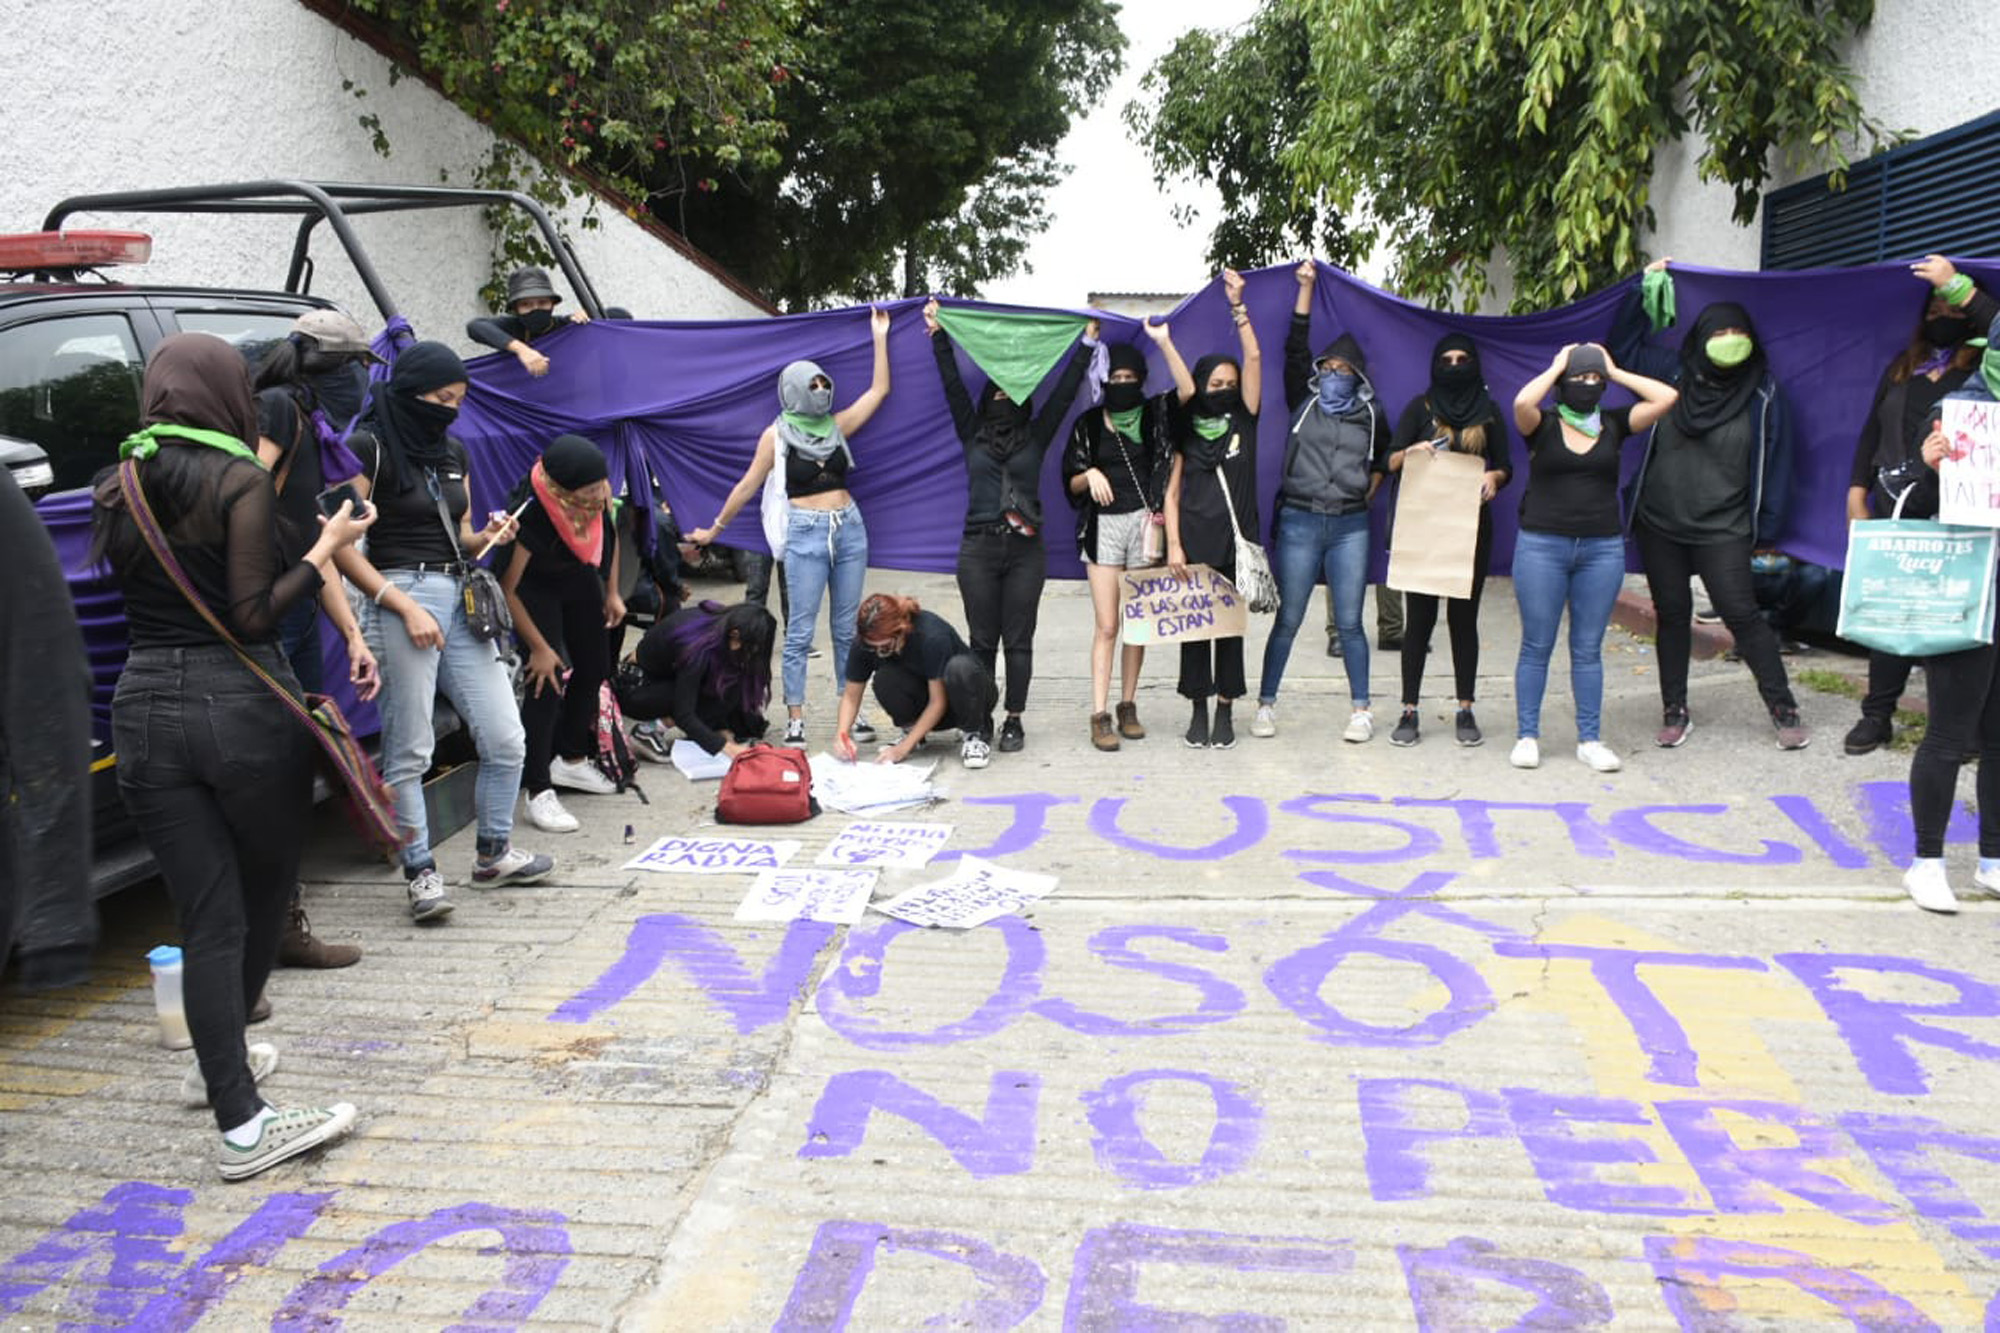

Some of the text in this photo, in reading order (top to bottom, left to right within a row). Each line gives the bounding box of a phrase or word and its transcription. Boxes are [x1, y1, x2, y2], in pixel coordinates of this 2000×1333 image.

[1867, 537, 1974, 554] ABARROTES
[1125, 573, 1181, 599] SOMOS
[1125, 602, 1144, 619] DE
[1150, 595, 1178, 614] LAS
[1181, 593, 1214, 611] QUE
[1157, 610, 1214, 637] ESTAN
[637, 852, 779, 868] RABIA
[659, 839, 776, 855] DIGNA
[797, 1069, 1263, 1190] NO
